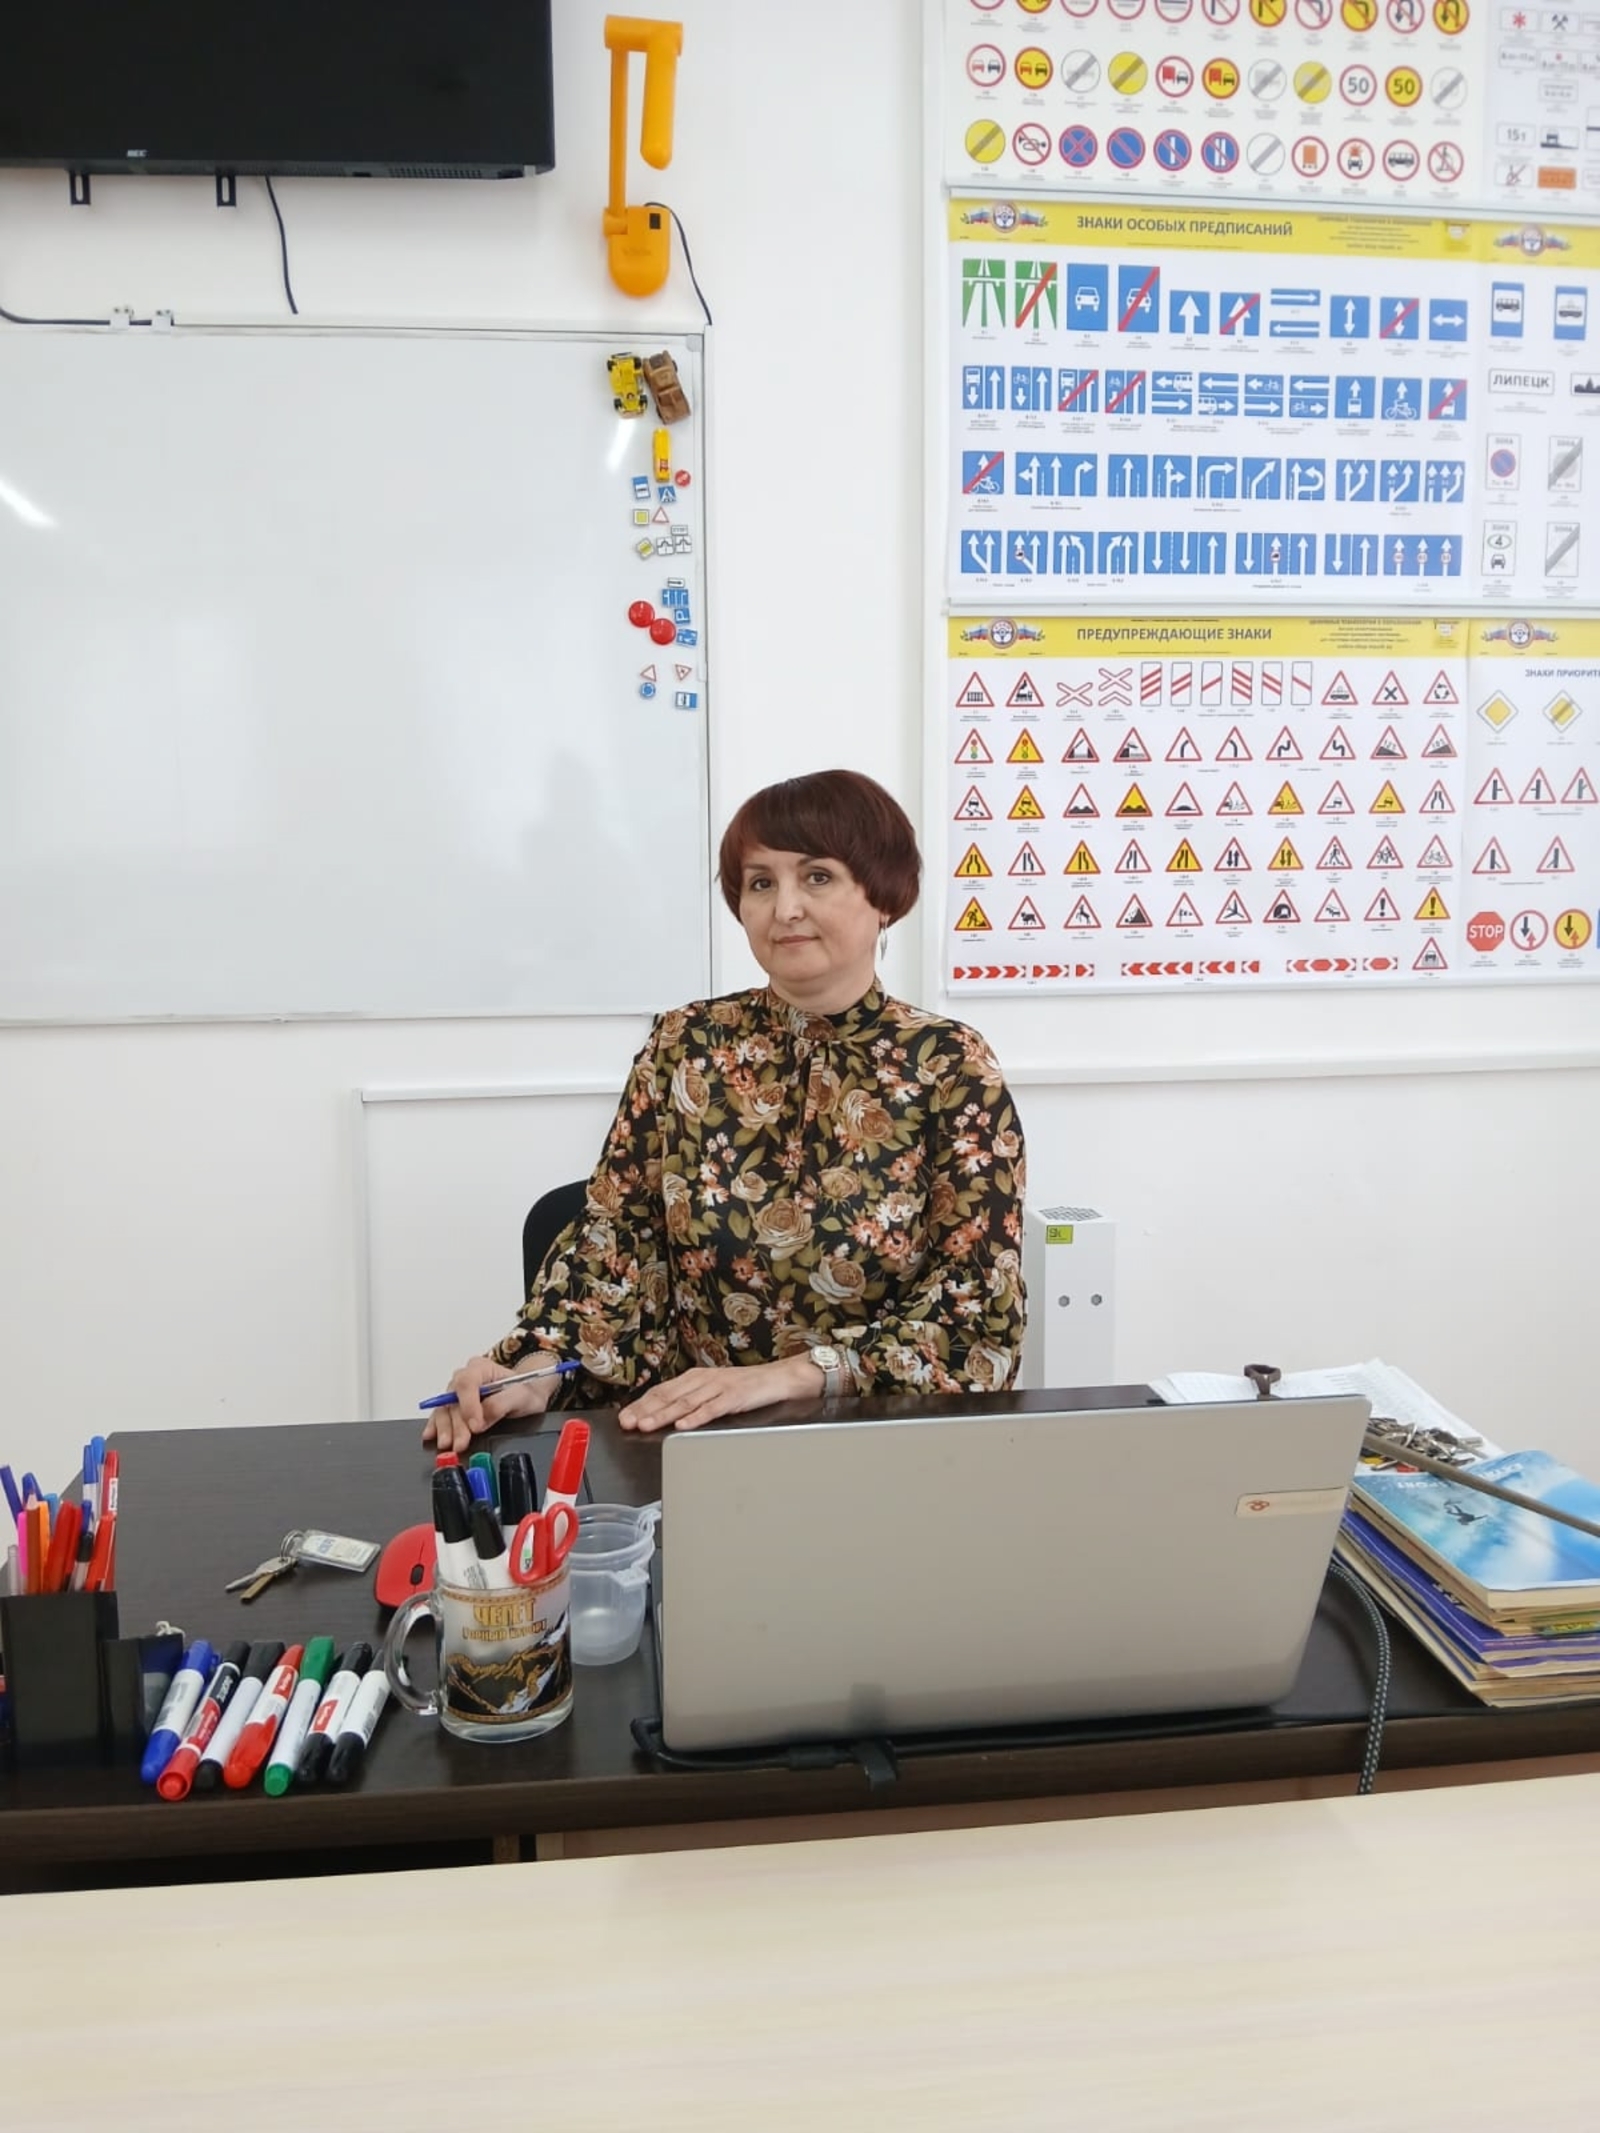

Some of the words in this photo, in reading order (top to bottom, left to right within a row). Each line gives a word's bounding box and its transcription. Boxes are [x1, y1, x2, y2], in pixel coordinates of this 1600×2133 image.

[1347, 76, 1370, 94] 50
[1393, 77, 1415, 95] 50
[1077, 216, 1123, 230] ЗНАКИ
[1126, 218, 1186, 233] ОСОБЫХ
[1189, 220, 1293, 236] ПРЕДПИСАНИЙ
[1493, 374, 1549, 388] ЛИПЕЦК
[1495, 535, 1503, 546] 4
[1077, 628, 1224, 642] ПРЕДУПРЕЖДАЮЩИЕ
[1227, 628, 1271, 640] ЗНАКИ
[1525, 668, 1554, 677] ЗНАКИ
[1469, 925, 1504, 939] STOP
